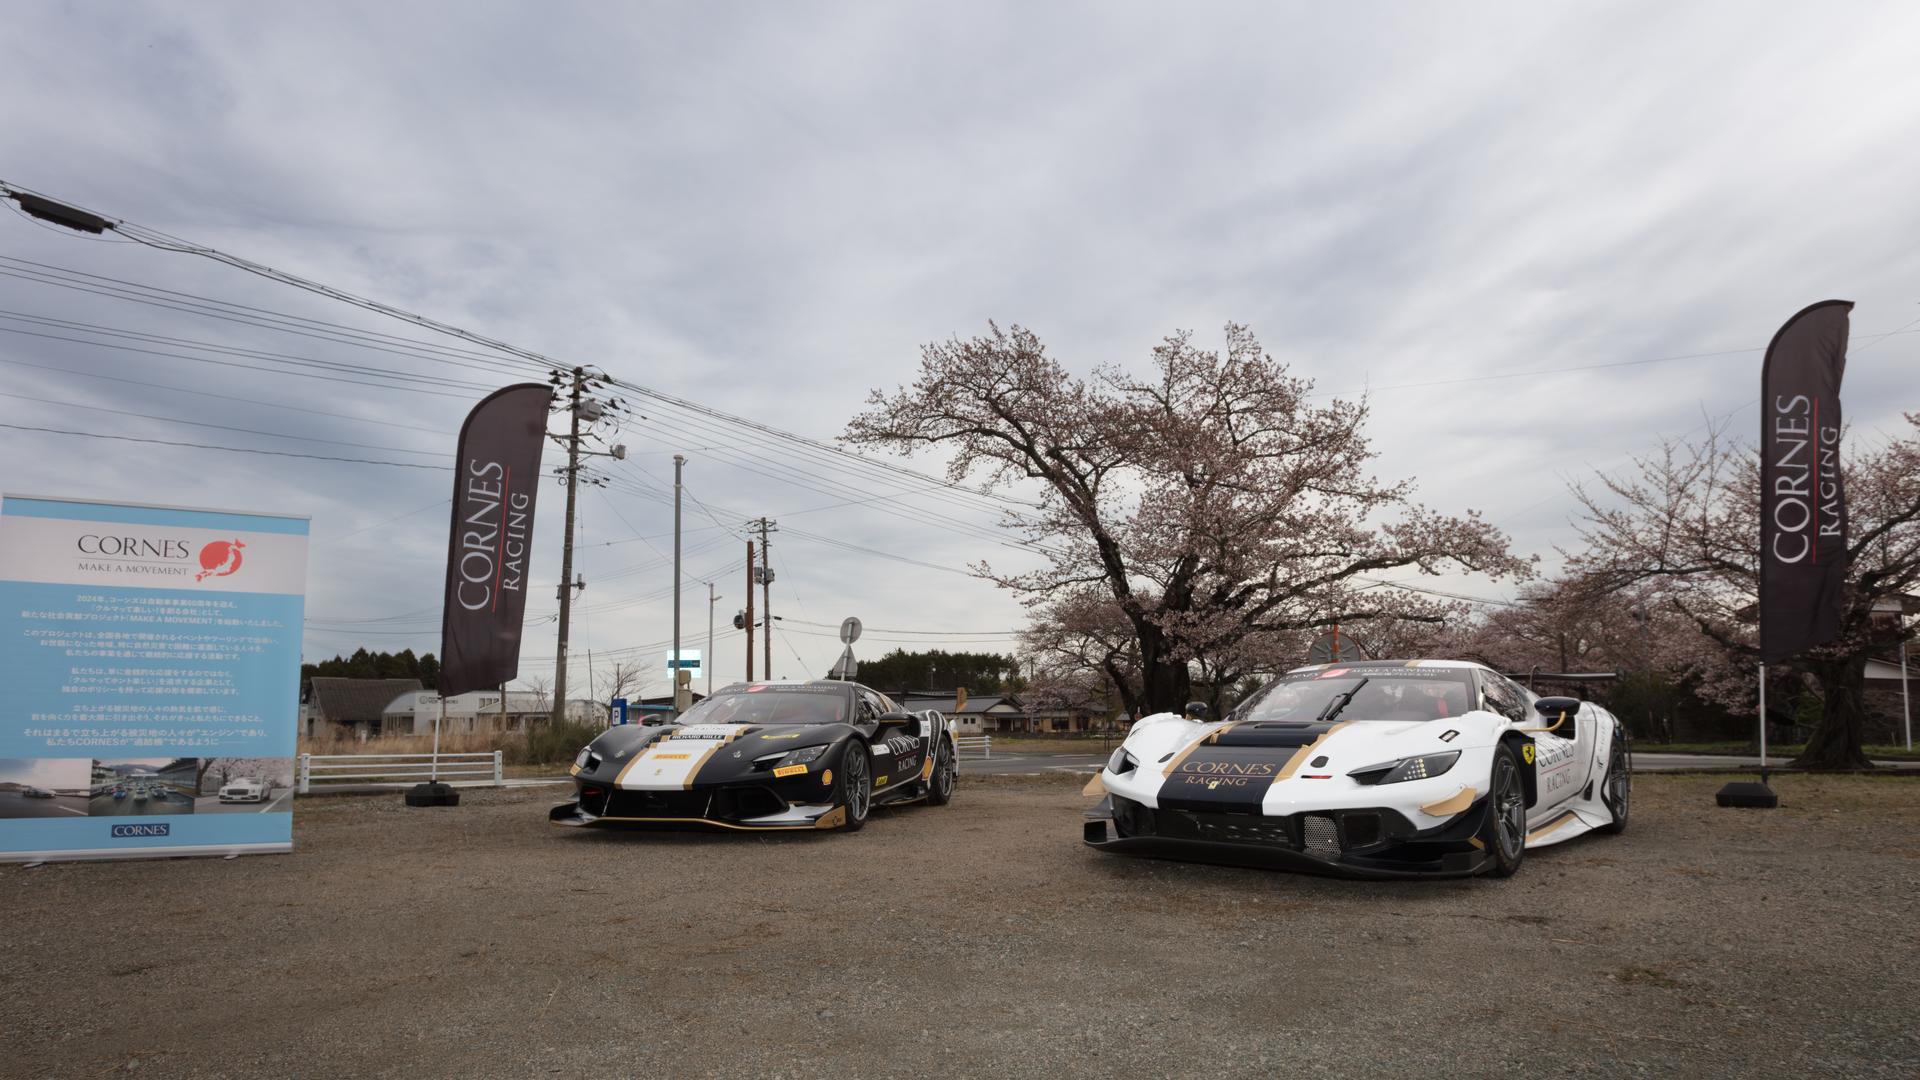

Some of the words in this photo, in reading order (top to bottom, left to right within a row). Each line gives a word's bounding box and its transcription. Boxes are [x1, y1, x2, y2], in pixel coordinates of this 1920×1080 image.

[1772, 393, 1811, 565] CORNES
[1819, 425, 1842, 537] RACING
[77, 533, 190, 560] CORNES
[457, 458, 503, 610] CORNES
[502, 492, 529, 592] RACING
[78, 562, 112, 573] MAKE
[115, 564, 123, 573] A
[126, 565, 190, 577] MOVEMENT
[1182, 761, 1277, 776] CORNES
[113, 825, 168, 837] CORNES
